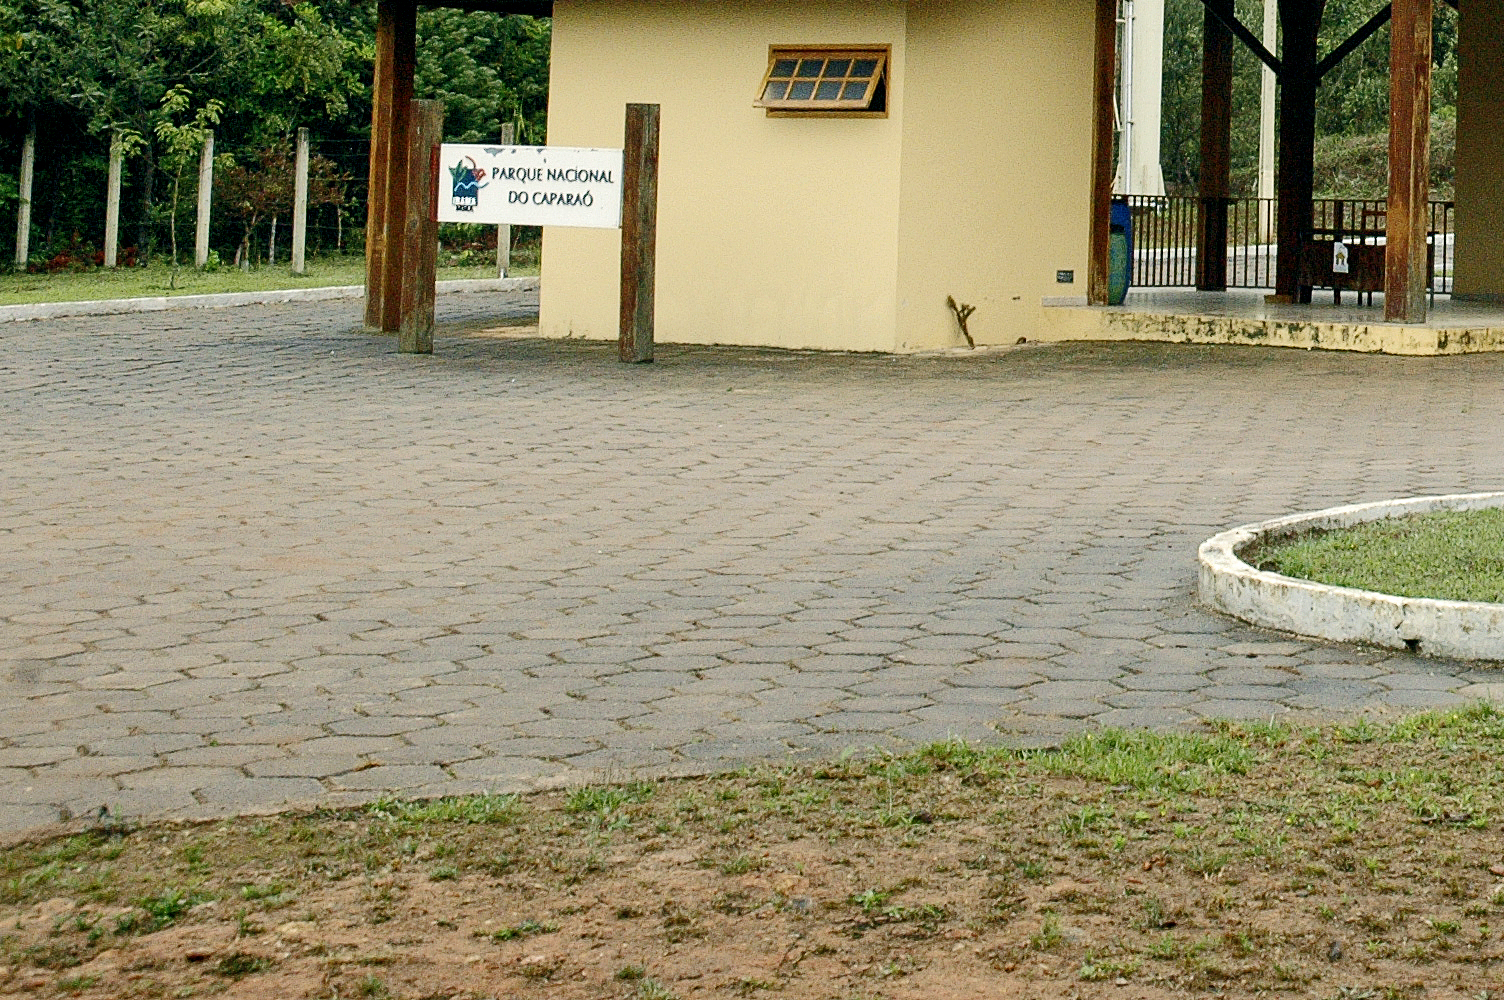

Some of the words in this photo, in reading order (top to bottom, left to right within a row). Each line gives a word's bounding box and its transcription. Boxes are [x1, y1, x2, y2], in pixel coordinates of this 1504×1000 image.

[491, 167, 543, 183] PARQUE
[546, 168, 614, 184] NACIONAL
[508, 190, 529, 205] DO
[532, 190, 594, 207] CAPARAÓ
